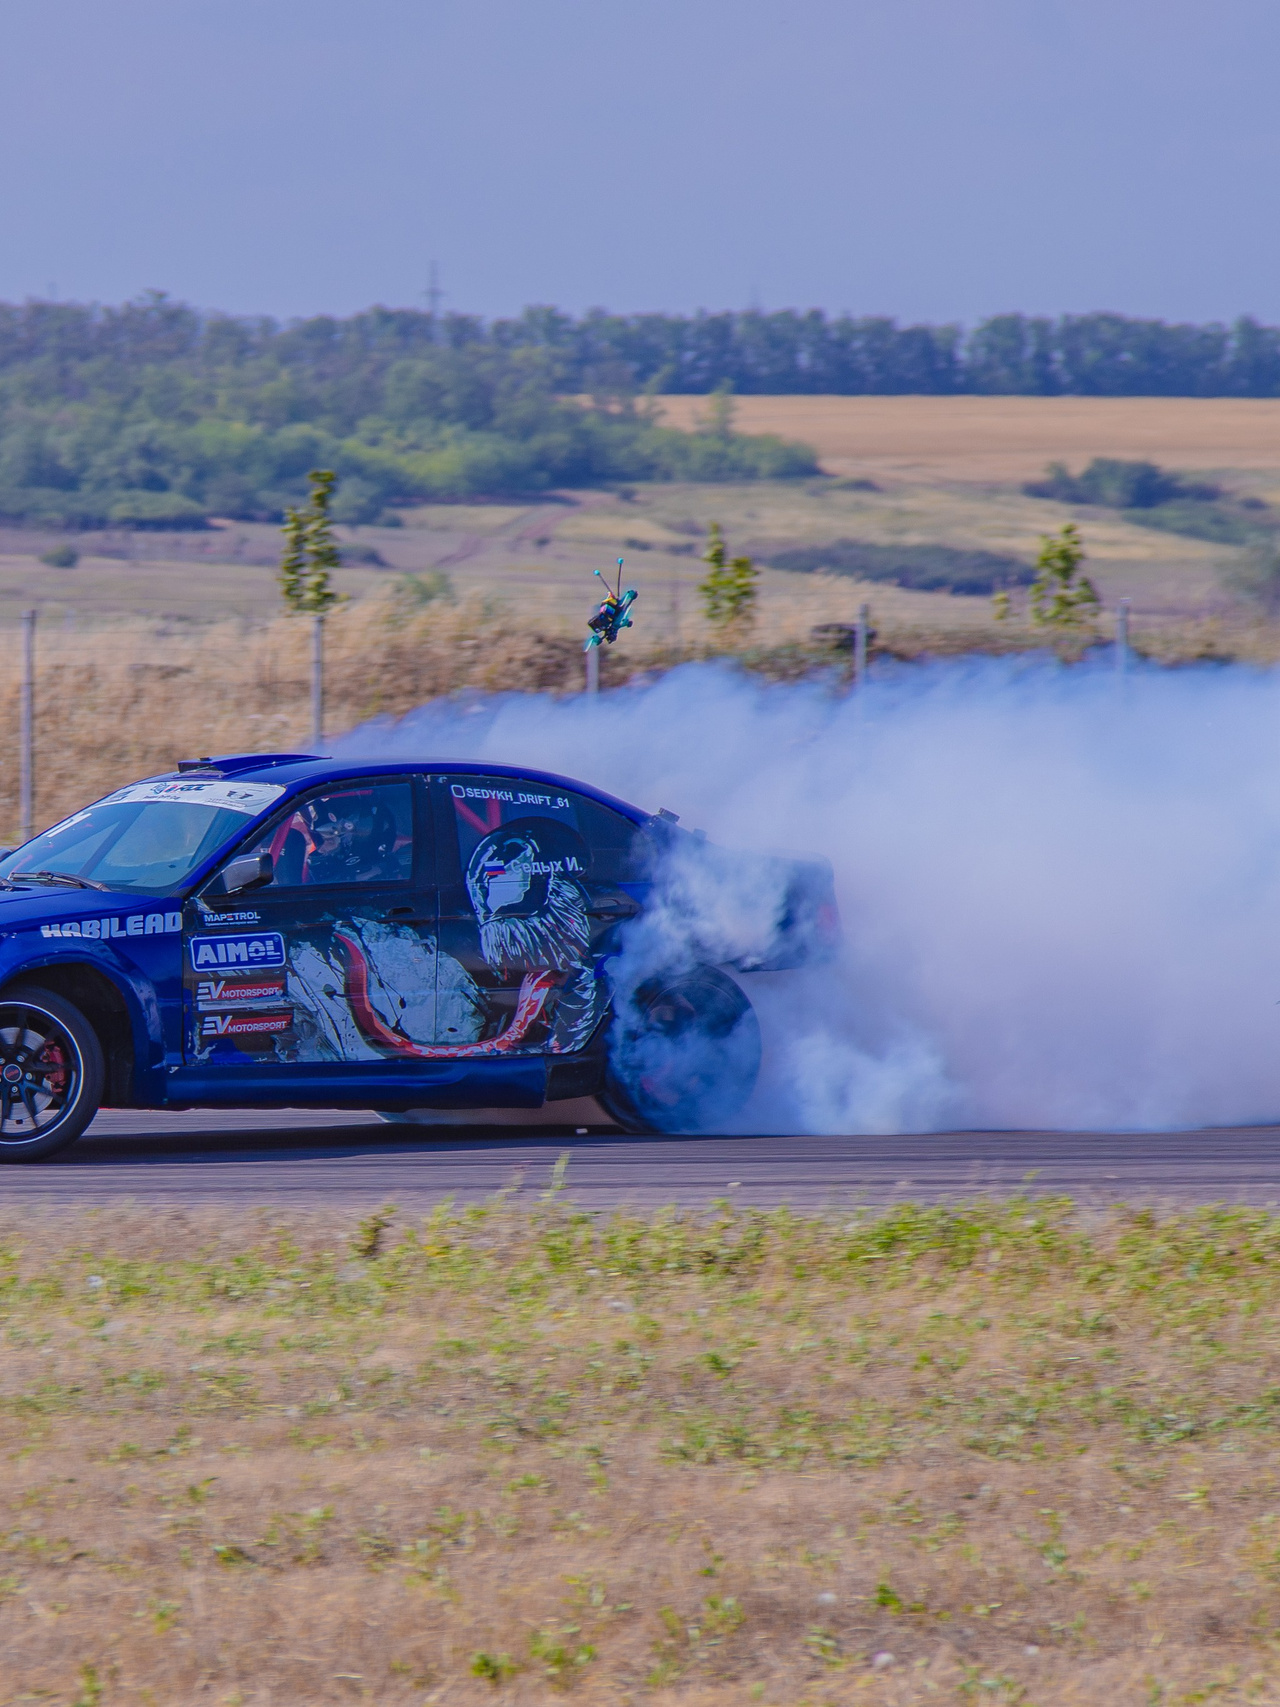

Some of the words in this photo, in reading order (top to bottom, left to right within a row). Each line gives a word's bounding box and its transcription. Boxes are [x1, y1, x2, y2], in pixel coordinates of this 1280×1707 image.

[466, 787, 570, 808] SEDYKH_DRIFT_61
[510, 859, 562, 876] Седых
[565, 856, 583, 872] И.
[40, 911, 183, 939] HABILEAD
[204, 912, 261, 922] MAPETROL
[196, 940, 281, 964] AIMOL
[222, 986, 280, 998] MOTORSPORT
[228, 1020, 287, 1033] MOTORSPORT
